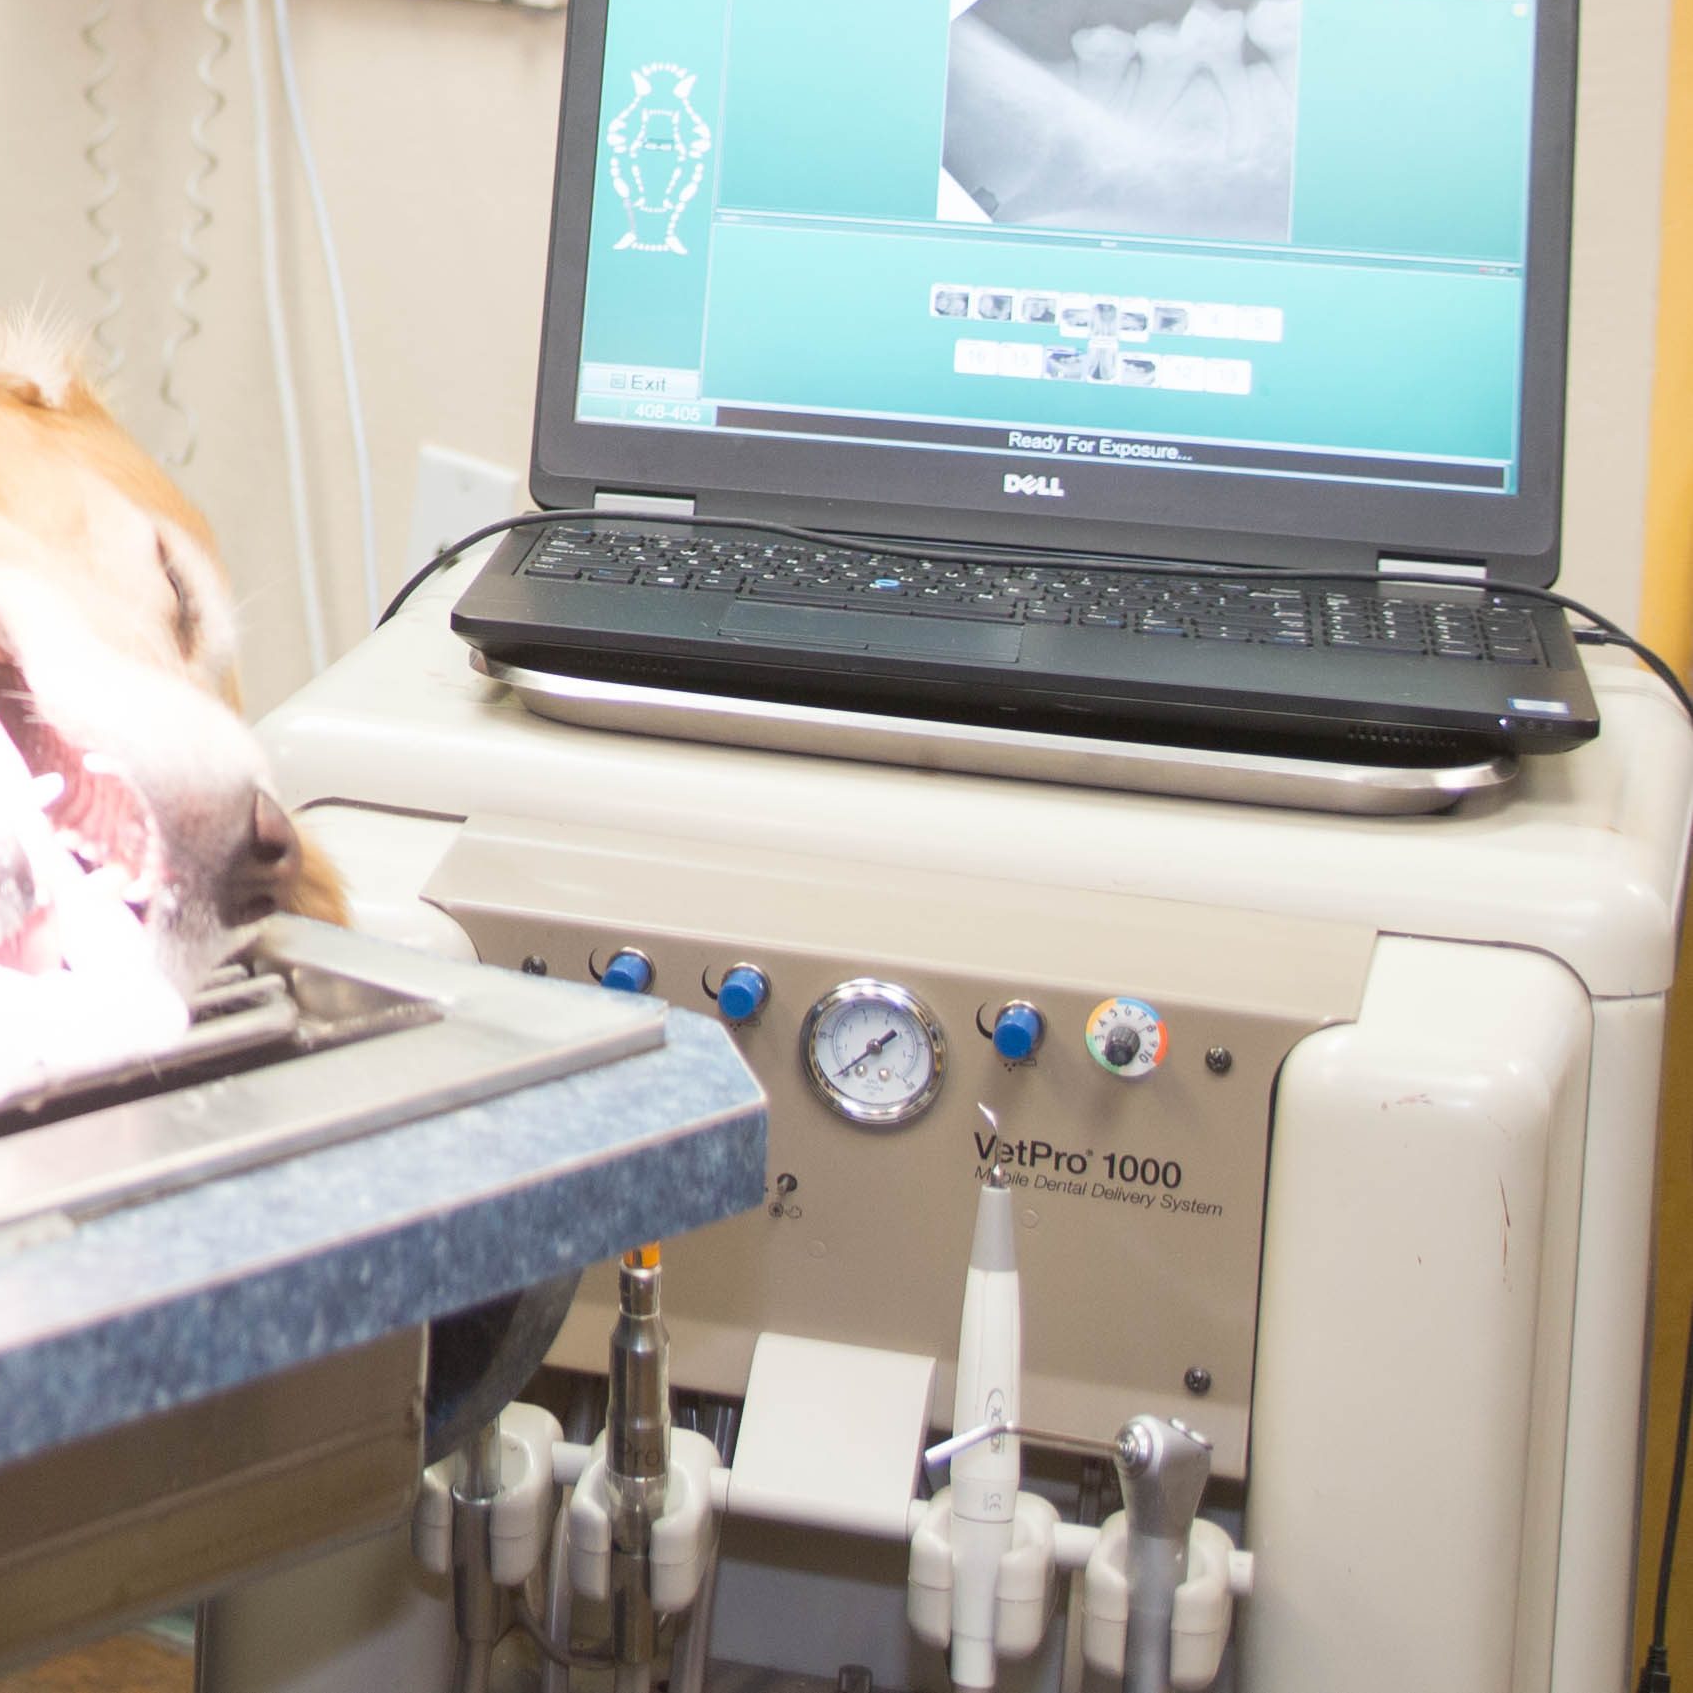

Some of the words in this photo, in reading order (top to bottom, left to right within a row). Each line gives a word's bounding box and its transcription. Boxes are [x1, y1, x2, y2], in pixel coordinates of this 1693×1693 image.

[630, 374, 667, 393] Exit
[634, 403, 702, 423] 408-405
[1007, 431, 1063, 454] Ready
[1067, 435, 1095, 454] For
[1099, 439, 1193, 463] Exposure...
[1003, 474, 1065, 498] DELL
[1103, 1150, 1183, 1191] 1000
[974, 1165, 1030, 1188] Mbile
[1035, 1173, 1088, 1198] Dental
[1091, 1182, 1157, 1209] Delivery
[1159, 1194, 1224, 1217] System
